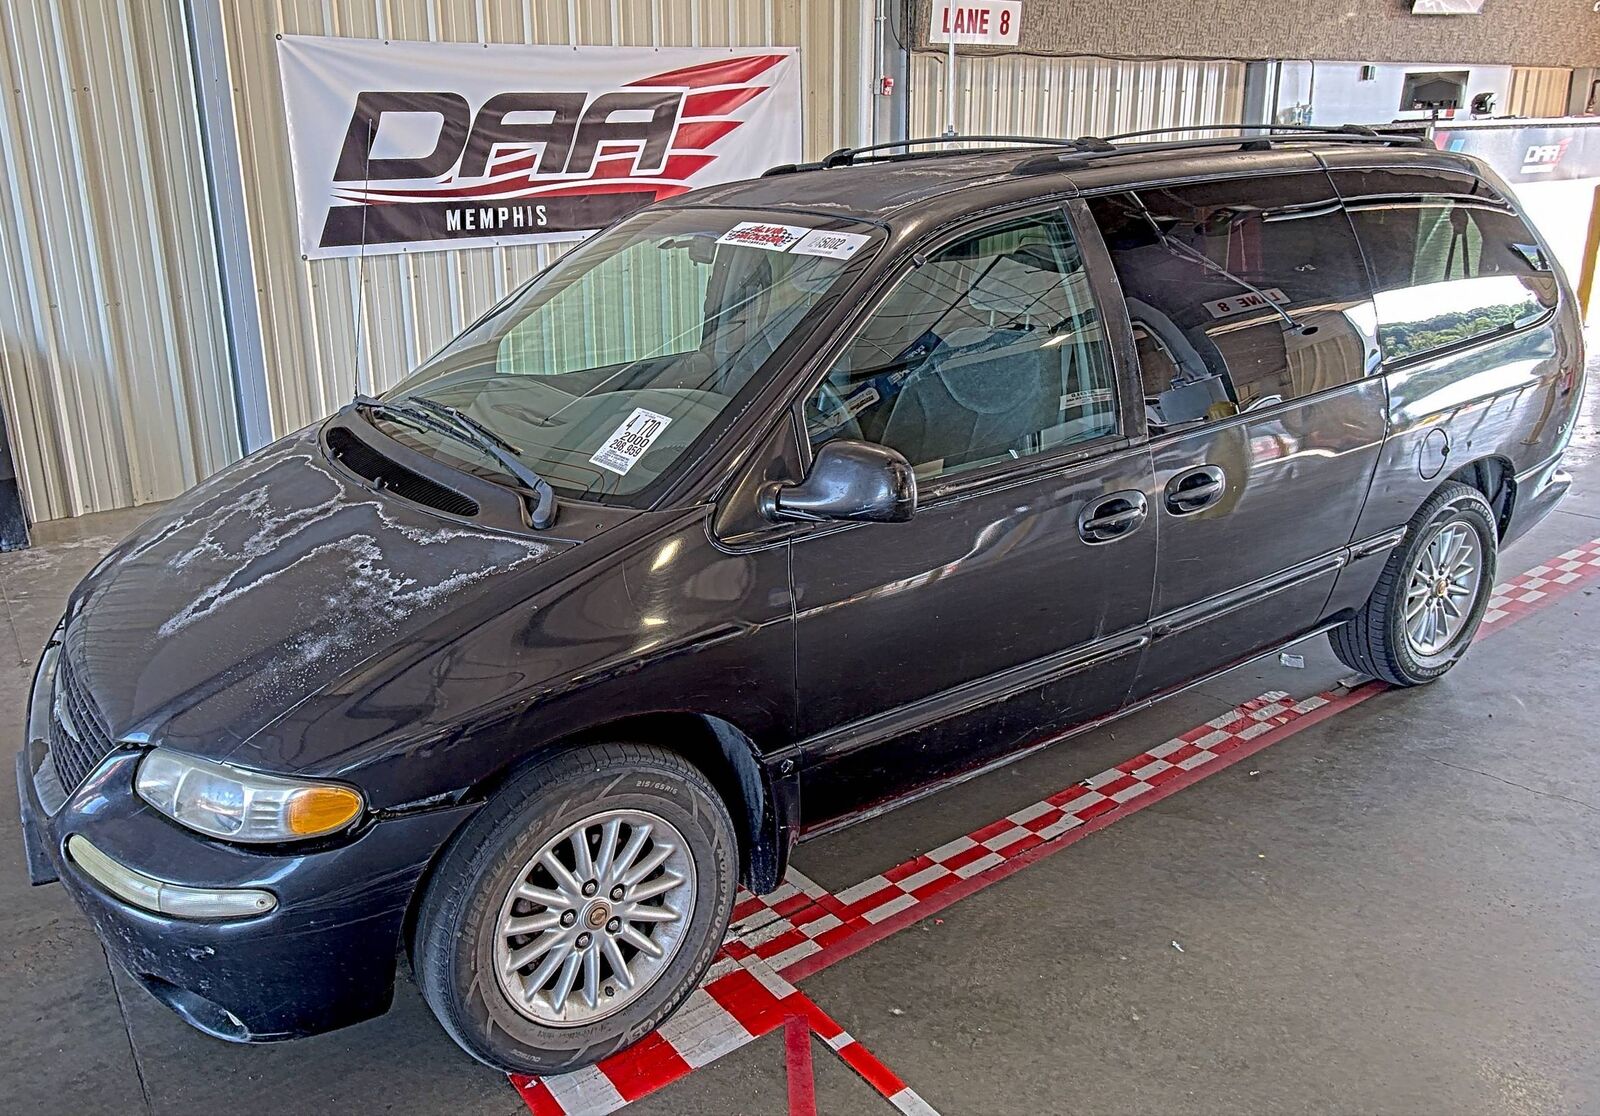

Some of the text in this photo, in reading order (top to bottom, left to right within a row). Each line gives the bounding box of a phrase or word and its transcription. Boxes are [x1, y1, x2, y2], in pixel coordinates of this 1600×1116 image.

[942, 8, 1011, 36] LANE 8
[332, 91, 685, 182] DAA
[446, 204, 548, 232] MEMPHIS
[625, 414, 641, 431] 4
[636, 418, 661, 438] 170
[609, 439, 643, 457] 298,959
[620, 431, 650, 448] 2000
[636, 780, 679, 795] 215/65R16
[462, 820, 542, 945] HERCULES
